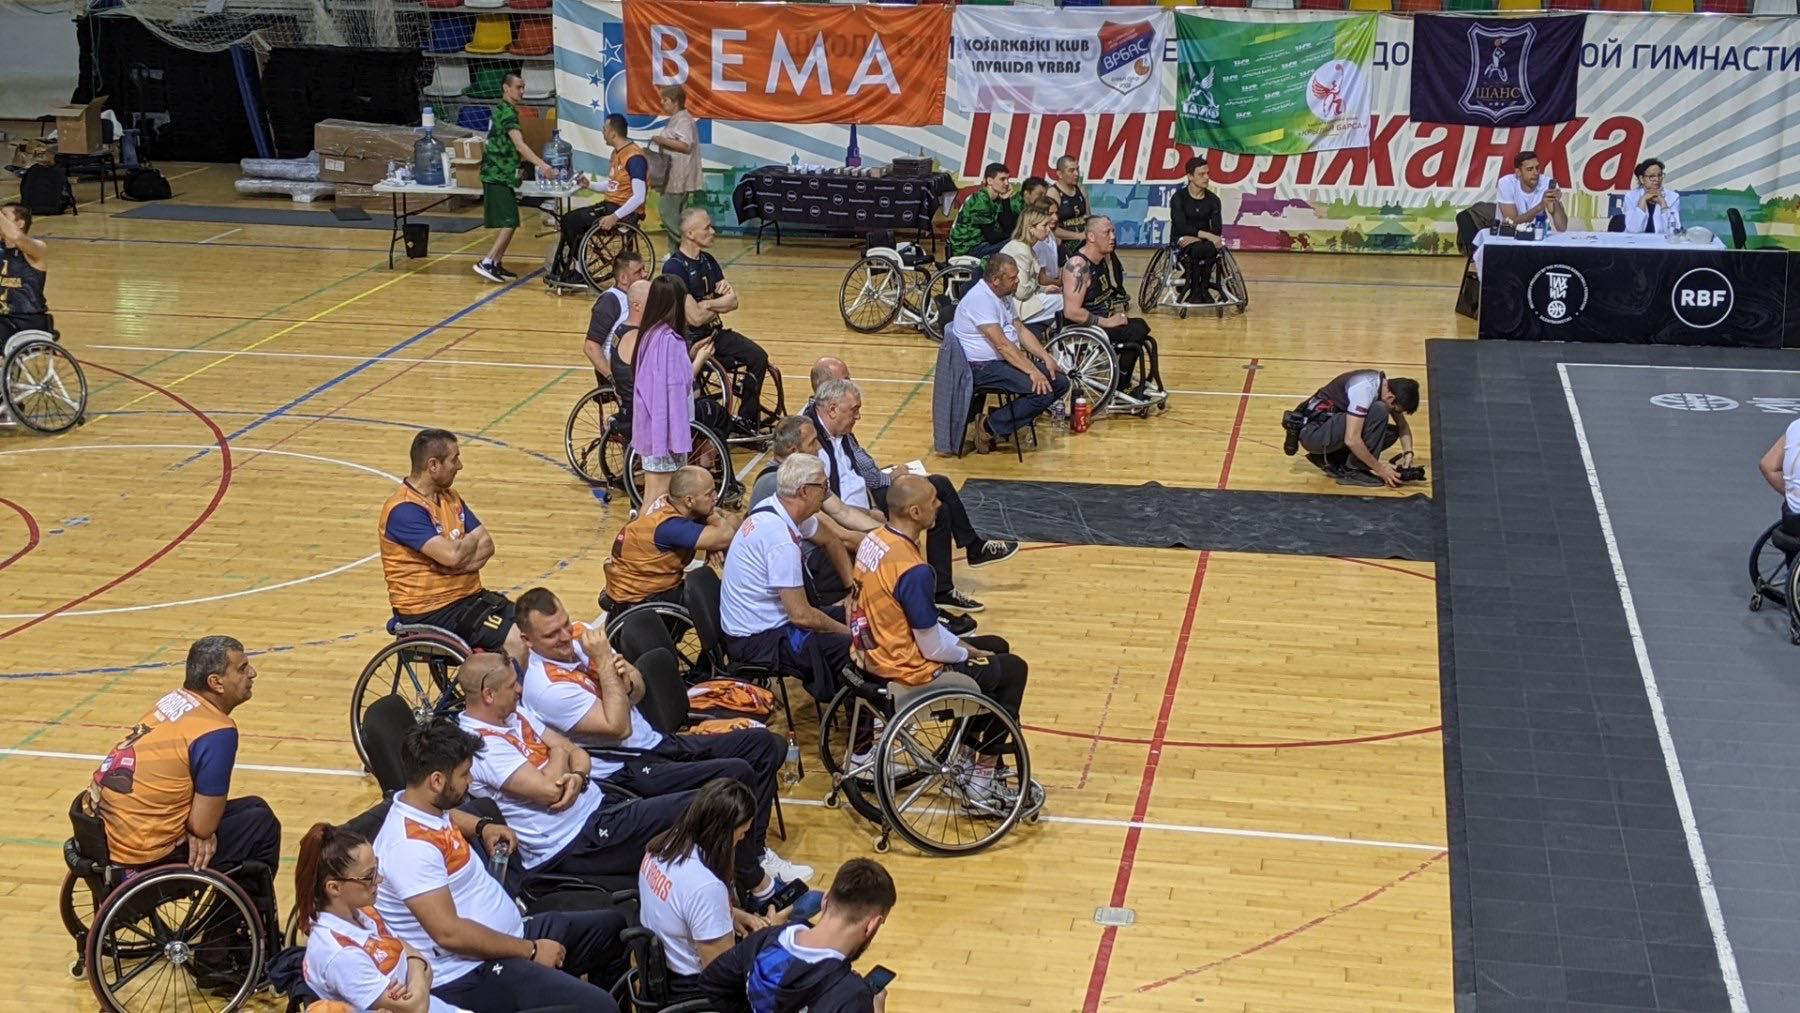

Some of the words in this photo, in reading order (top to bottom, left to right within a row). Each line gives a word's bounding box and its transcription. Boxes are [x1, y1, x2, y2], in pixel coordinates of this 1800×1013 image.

[963, 36, 1051, 52] KOŠARKAŠKI
[1055, 38, 1090, 52] KLUB
[1103, 39, 1148, 70] ВРБАС
[1037, 60, 1081, 73] VRBAS
[1476, 87, 1521, 99] ШАНС
[1681, 289, 1726, 307] RBF
